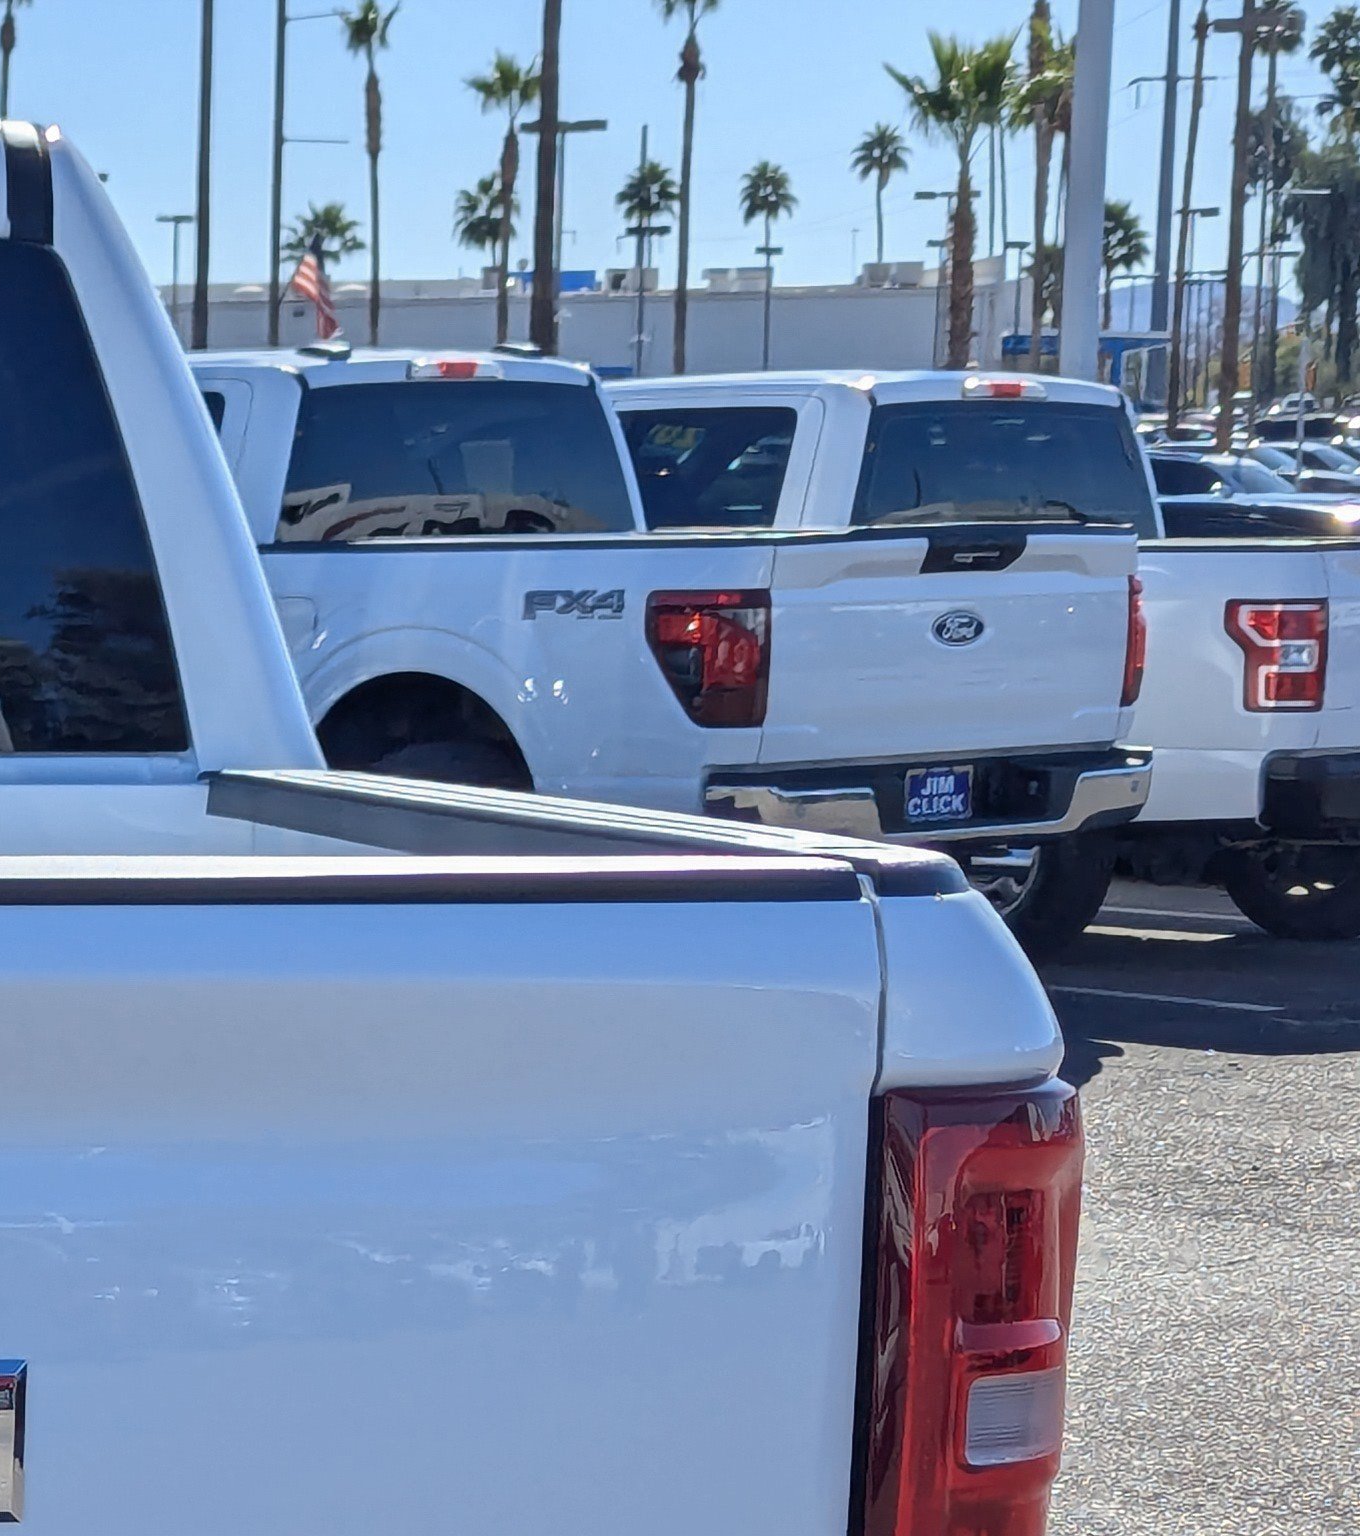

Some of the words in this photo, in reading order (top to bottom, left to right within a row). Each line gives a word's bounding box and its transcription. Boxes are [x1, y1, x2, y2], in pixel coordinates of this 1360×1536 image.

[522, 589, 625, 620] FX4
[921, 775, 955, 796] JIM
[907, 793, 966, 816] CLICK
